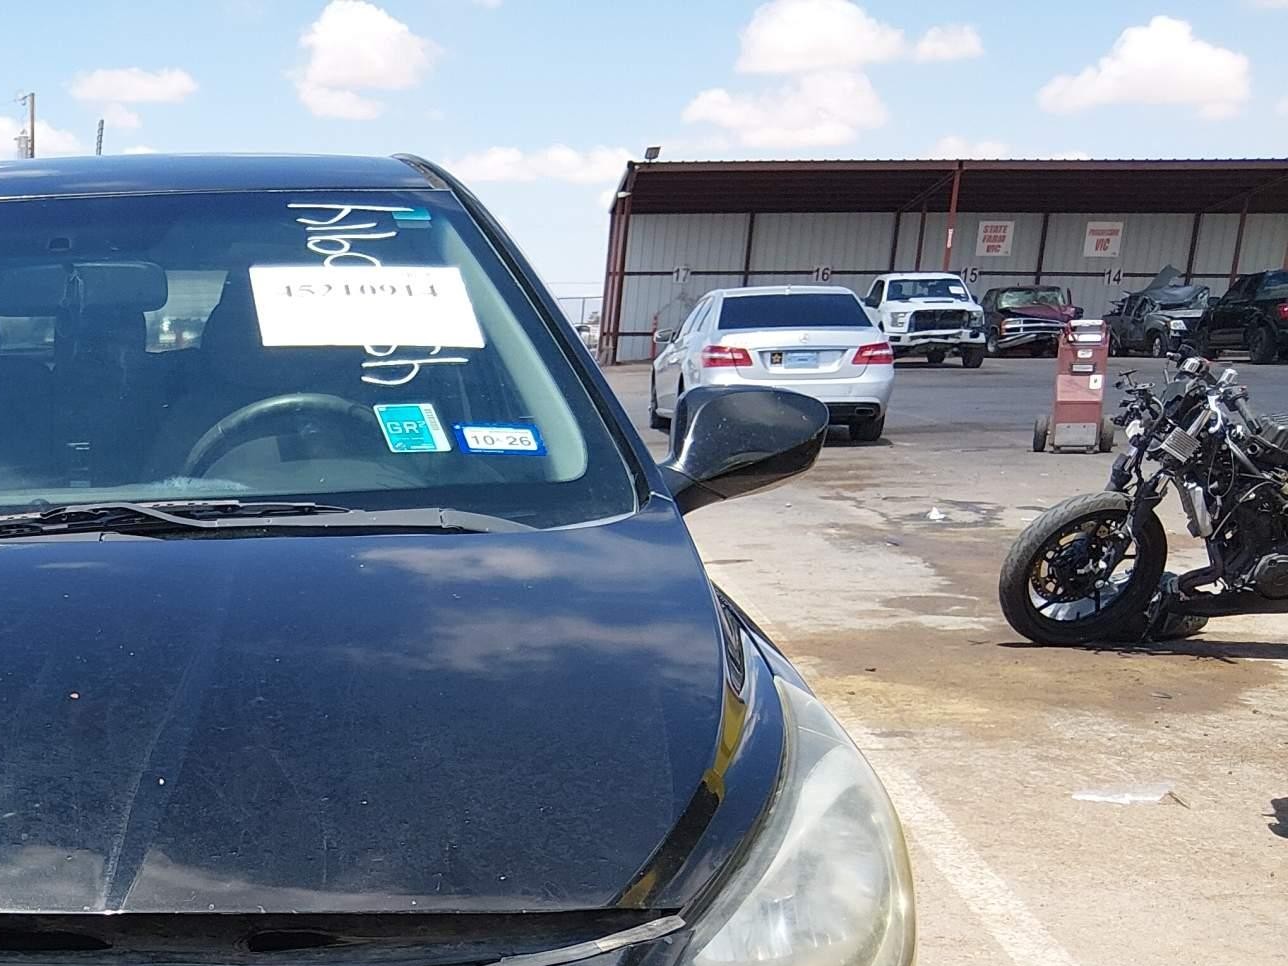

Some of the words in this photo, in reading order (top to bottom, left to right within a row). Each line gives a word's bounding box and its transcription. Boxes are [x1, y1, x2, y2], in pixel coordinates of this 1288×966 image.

[1095, 239, 1111, 251] VIC
[674, 268, 690, 282] 17
[815, 268, 830, 281] 16
[962, 268, 978, 282] 15
[1106, 270, 1121, 284] 14
